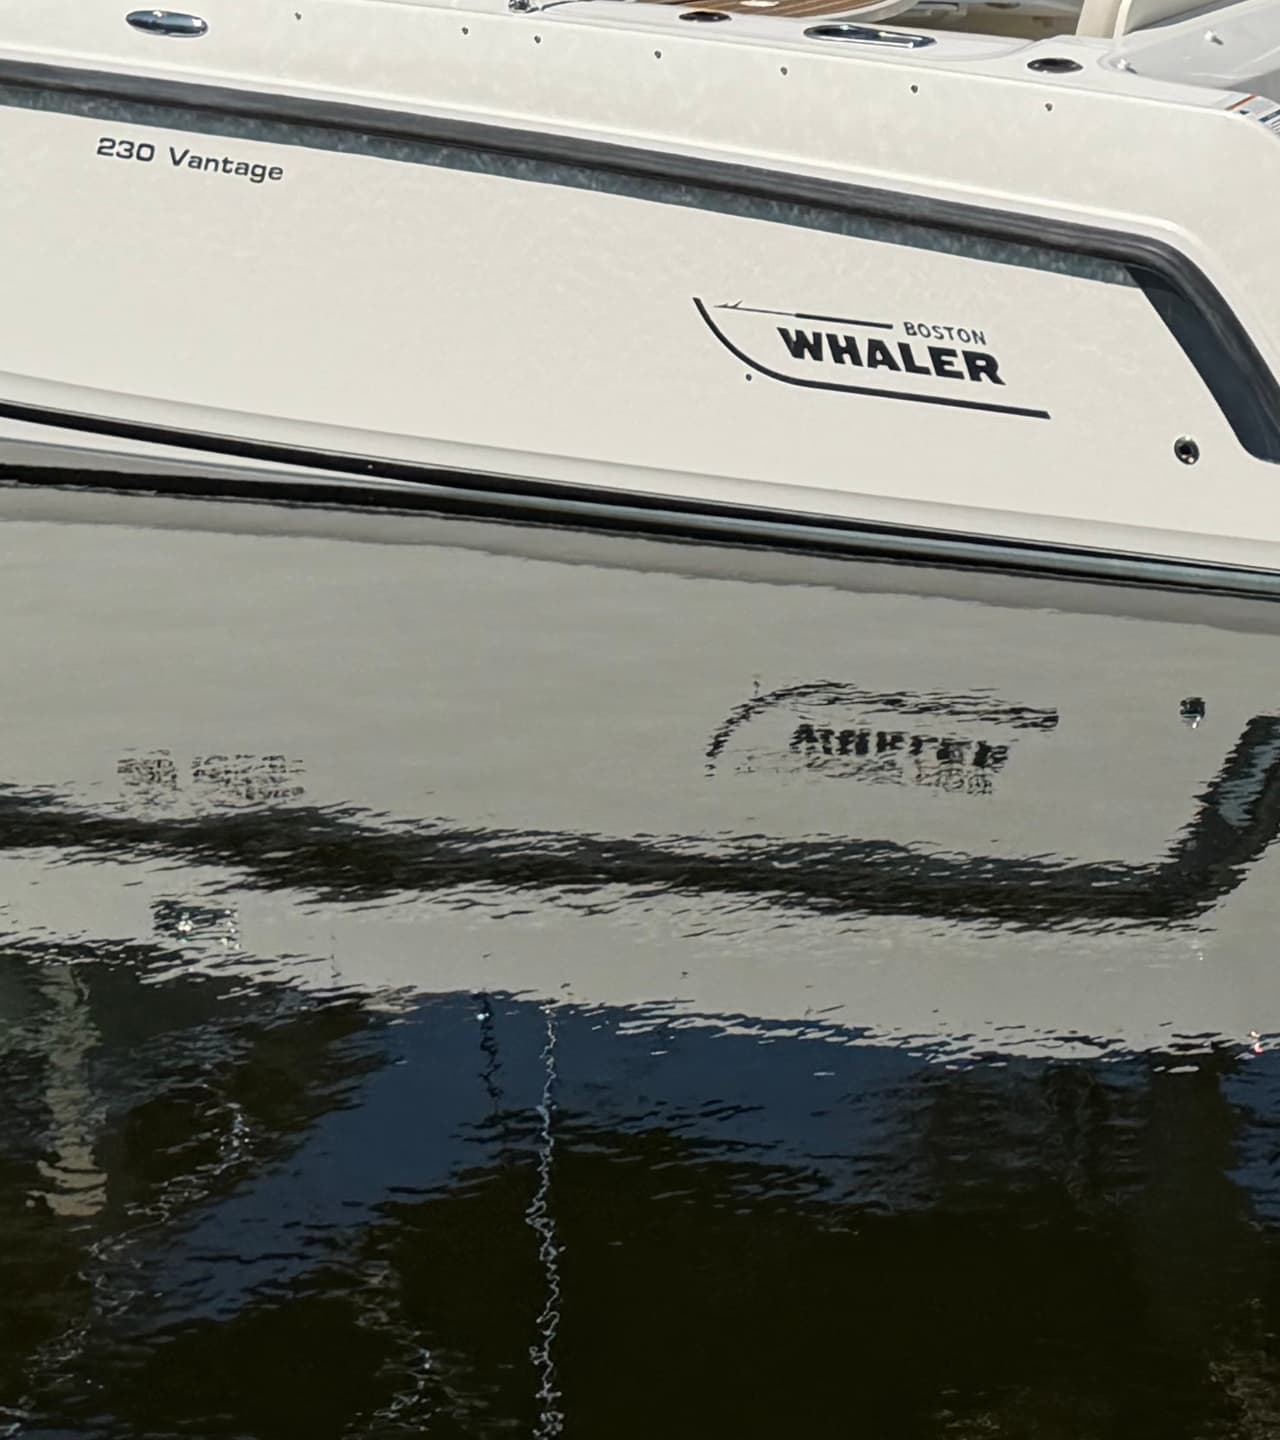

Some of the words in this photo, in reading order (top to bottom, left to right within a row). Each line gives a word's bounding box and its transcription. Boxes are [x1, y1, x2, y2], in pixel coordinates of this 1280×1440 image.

[96, 137, 156, 162] 230
[169, 146, 285, 184] Vantage
[777, 326, 1007, 386] WHALER
[903, 321, 987, 345] BOSTON
